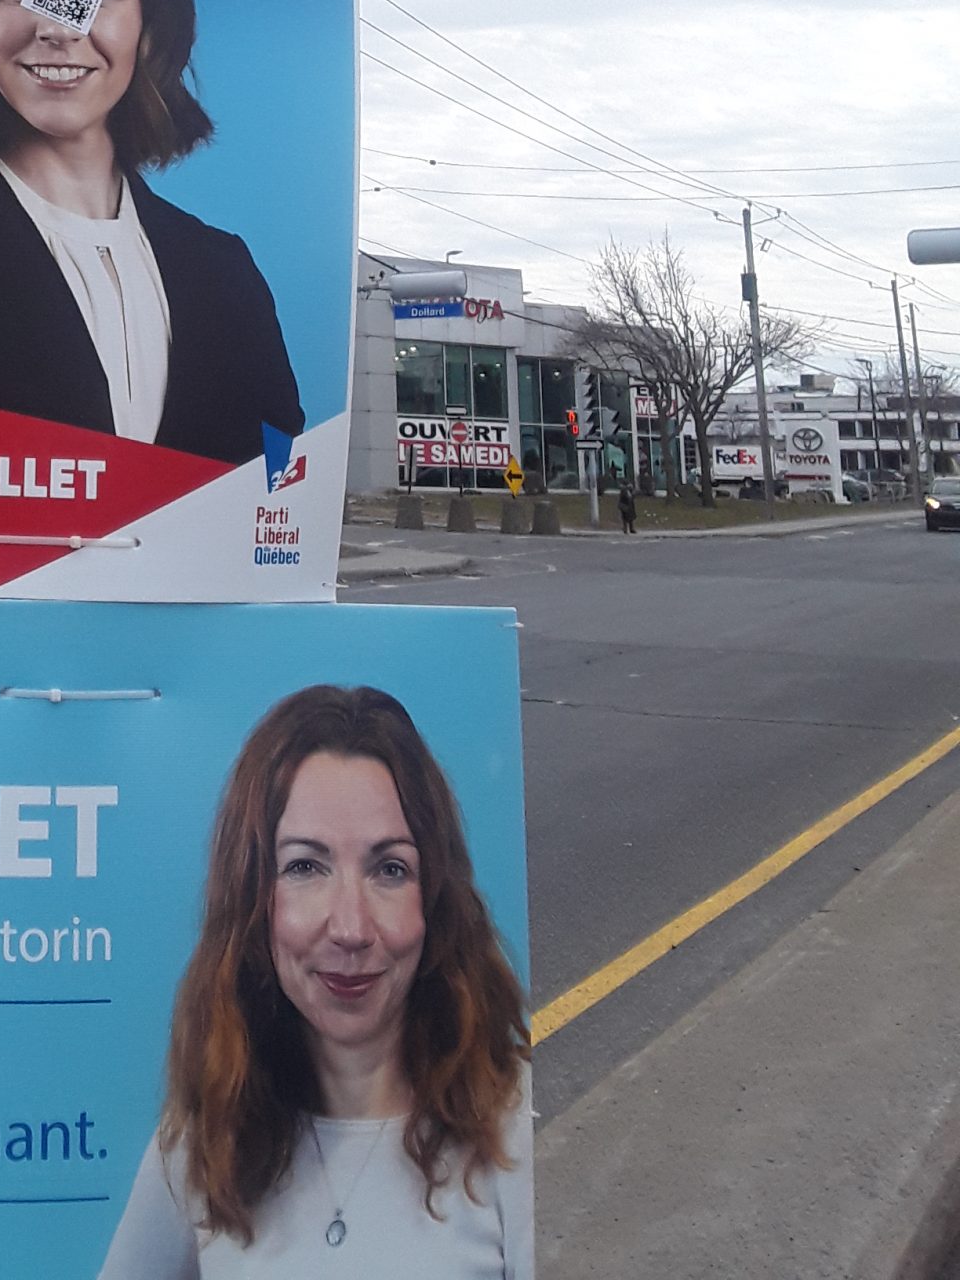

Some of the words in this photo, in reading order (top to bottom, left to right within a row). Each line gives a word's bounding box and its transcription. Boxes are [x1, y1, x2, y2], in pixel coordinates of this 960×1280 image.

[411, 307, 445, 317] Dollard
[430, 443, 509, 465] SAMEDI
[715, 449, 757, 465] FedEx
[789, 454, 831, 465] TOYOTA
[256, 506, 289, 524] Parti
[255, 526, 300, 545] Libéral
[254, 546, 301, 566] Québec
